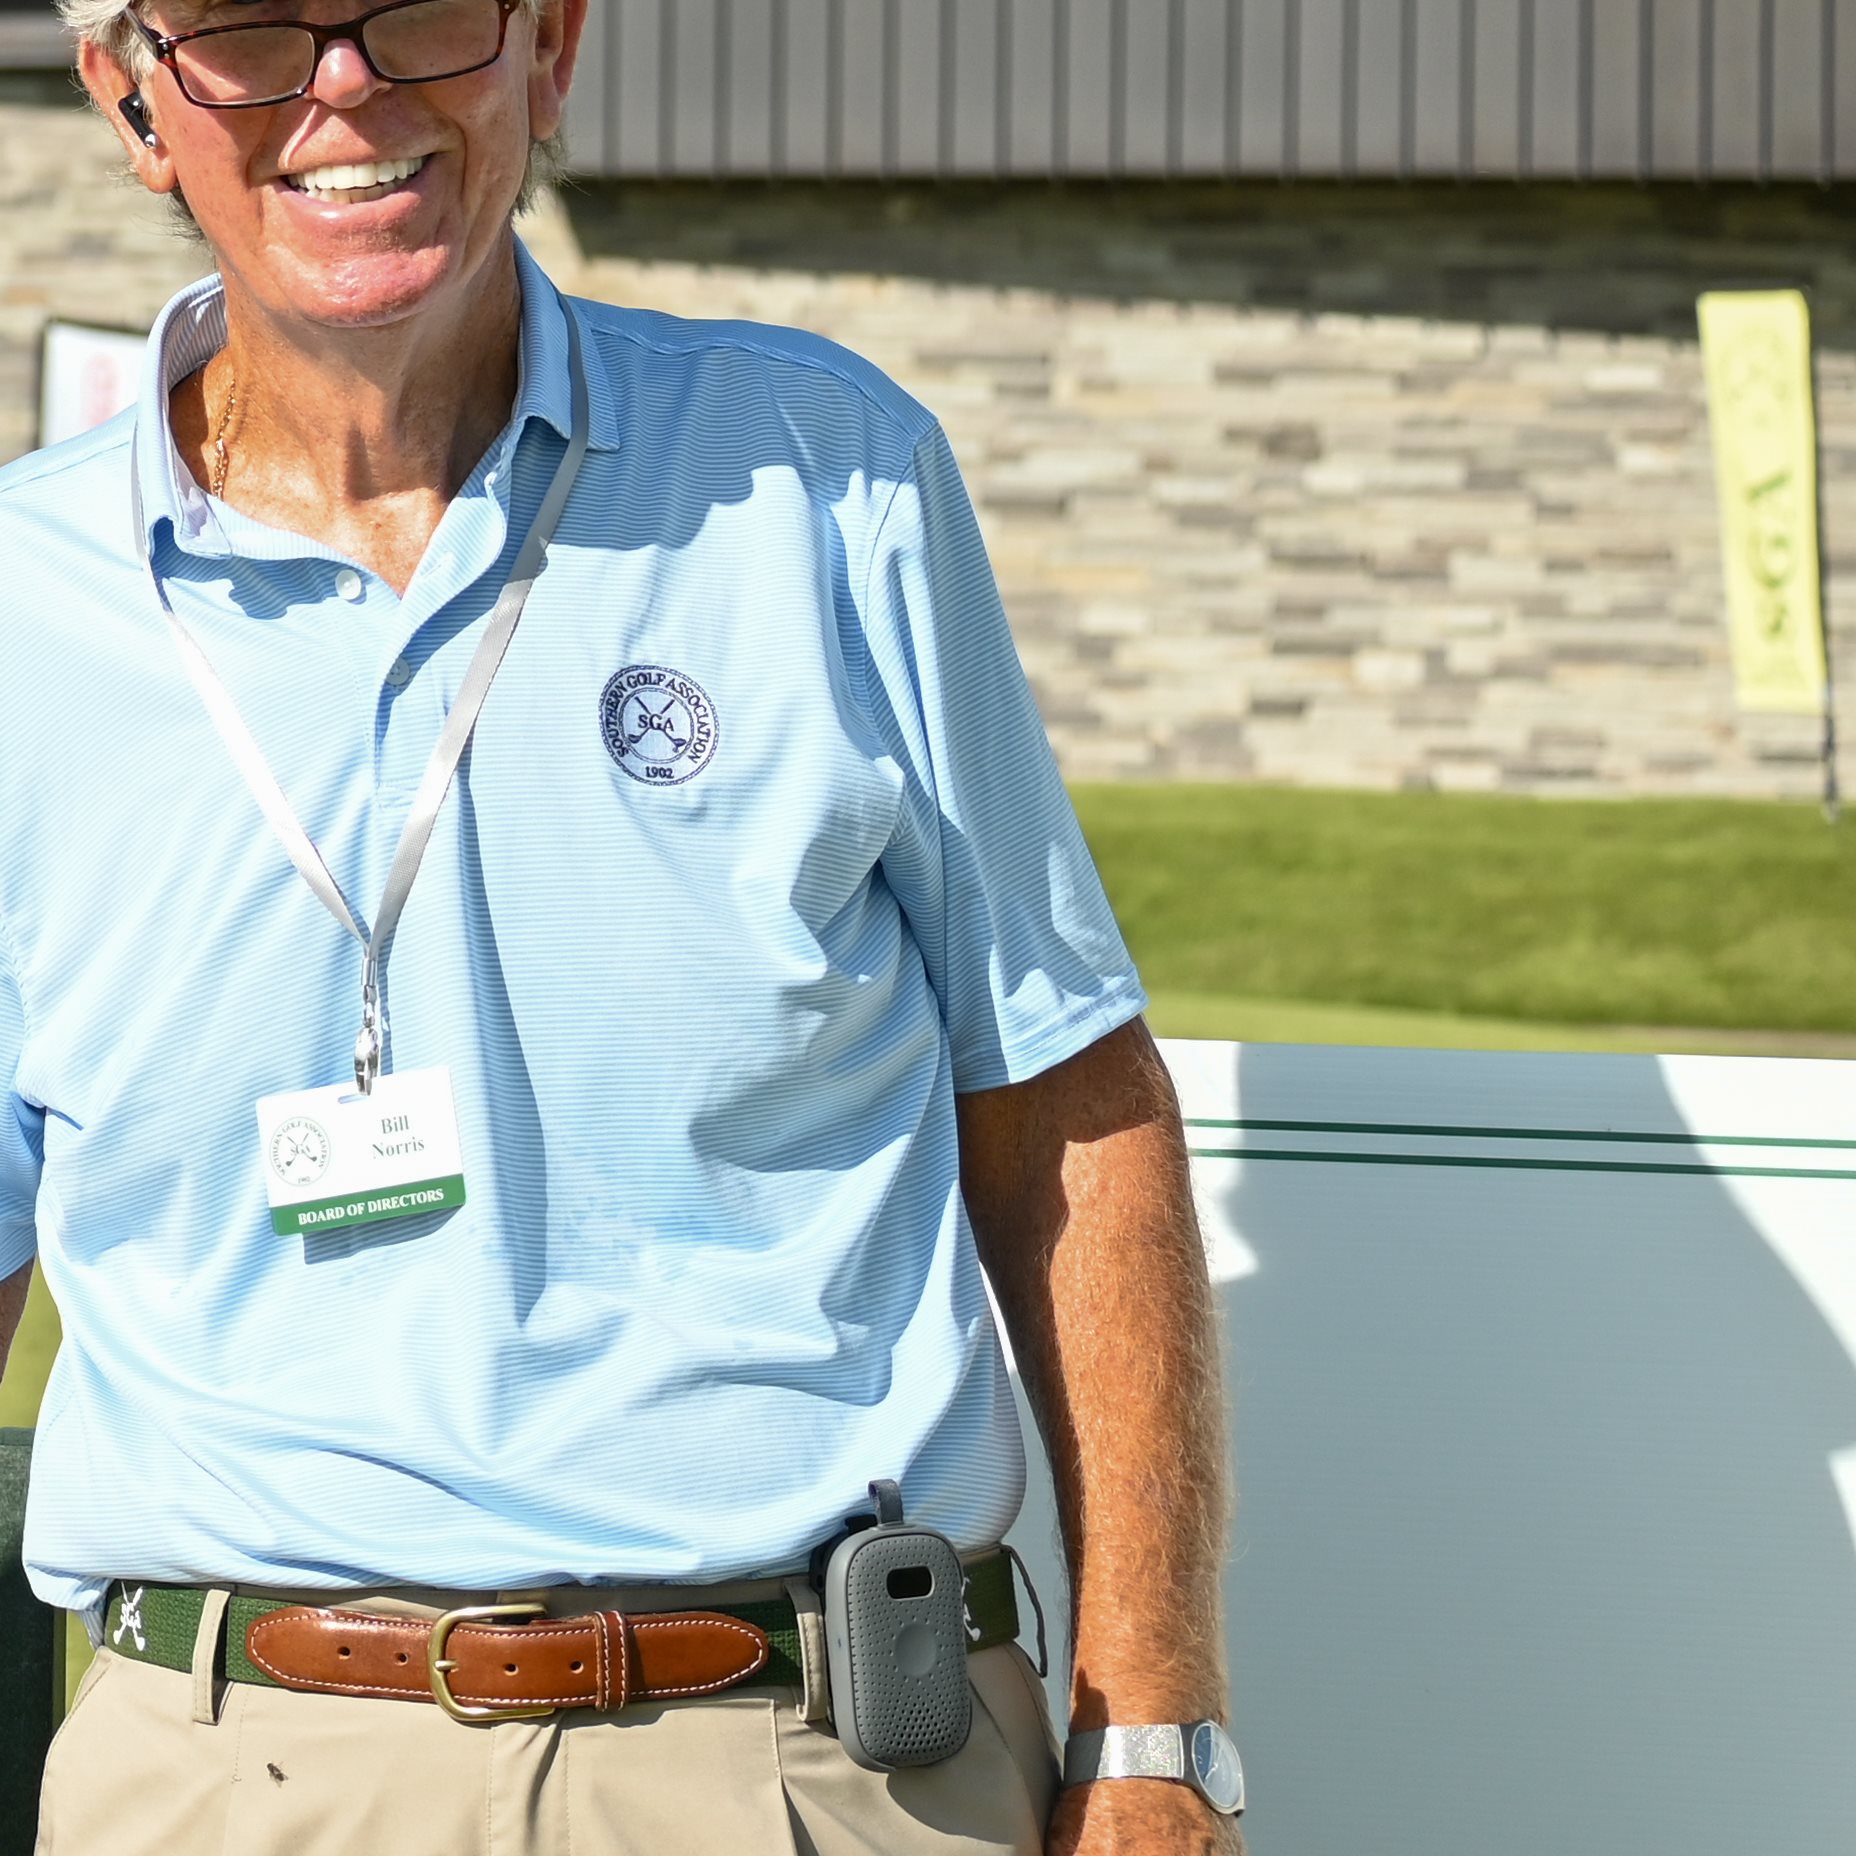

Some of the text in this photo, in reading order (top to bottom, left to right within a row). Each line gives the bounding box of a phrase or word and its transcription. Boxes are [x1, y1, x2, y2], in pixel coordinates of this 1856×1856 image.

[604, 672, 712, 764] SOUTHERN GOLF ASSOCIATION
[637, 713, 675, 732] SGA
[645, 765, 675, 780] 1902
[380, 1114, 410, 1135] Bill
[371, 1136, 425, 1159] Norris
[297, 1187, 445, 1226] BOARD OF DIRECTORS
